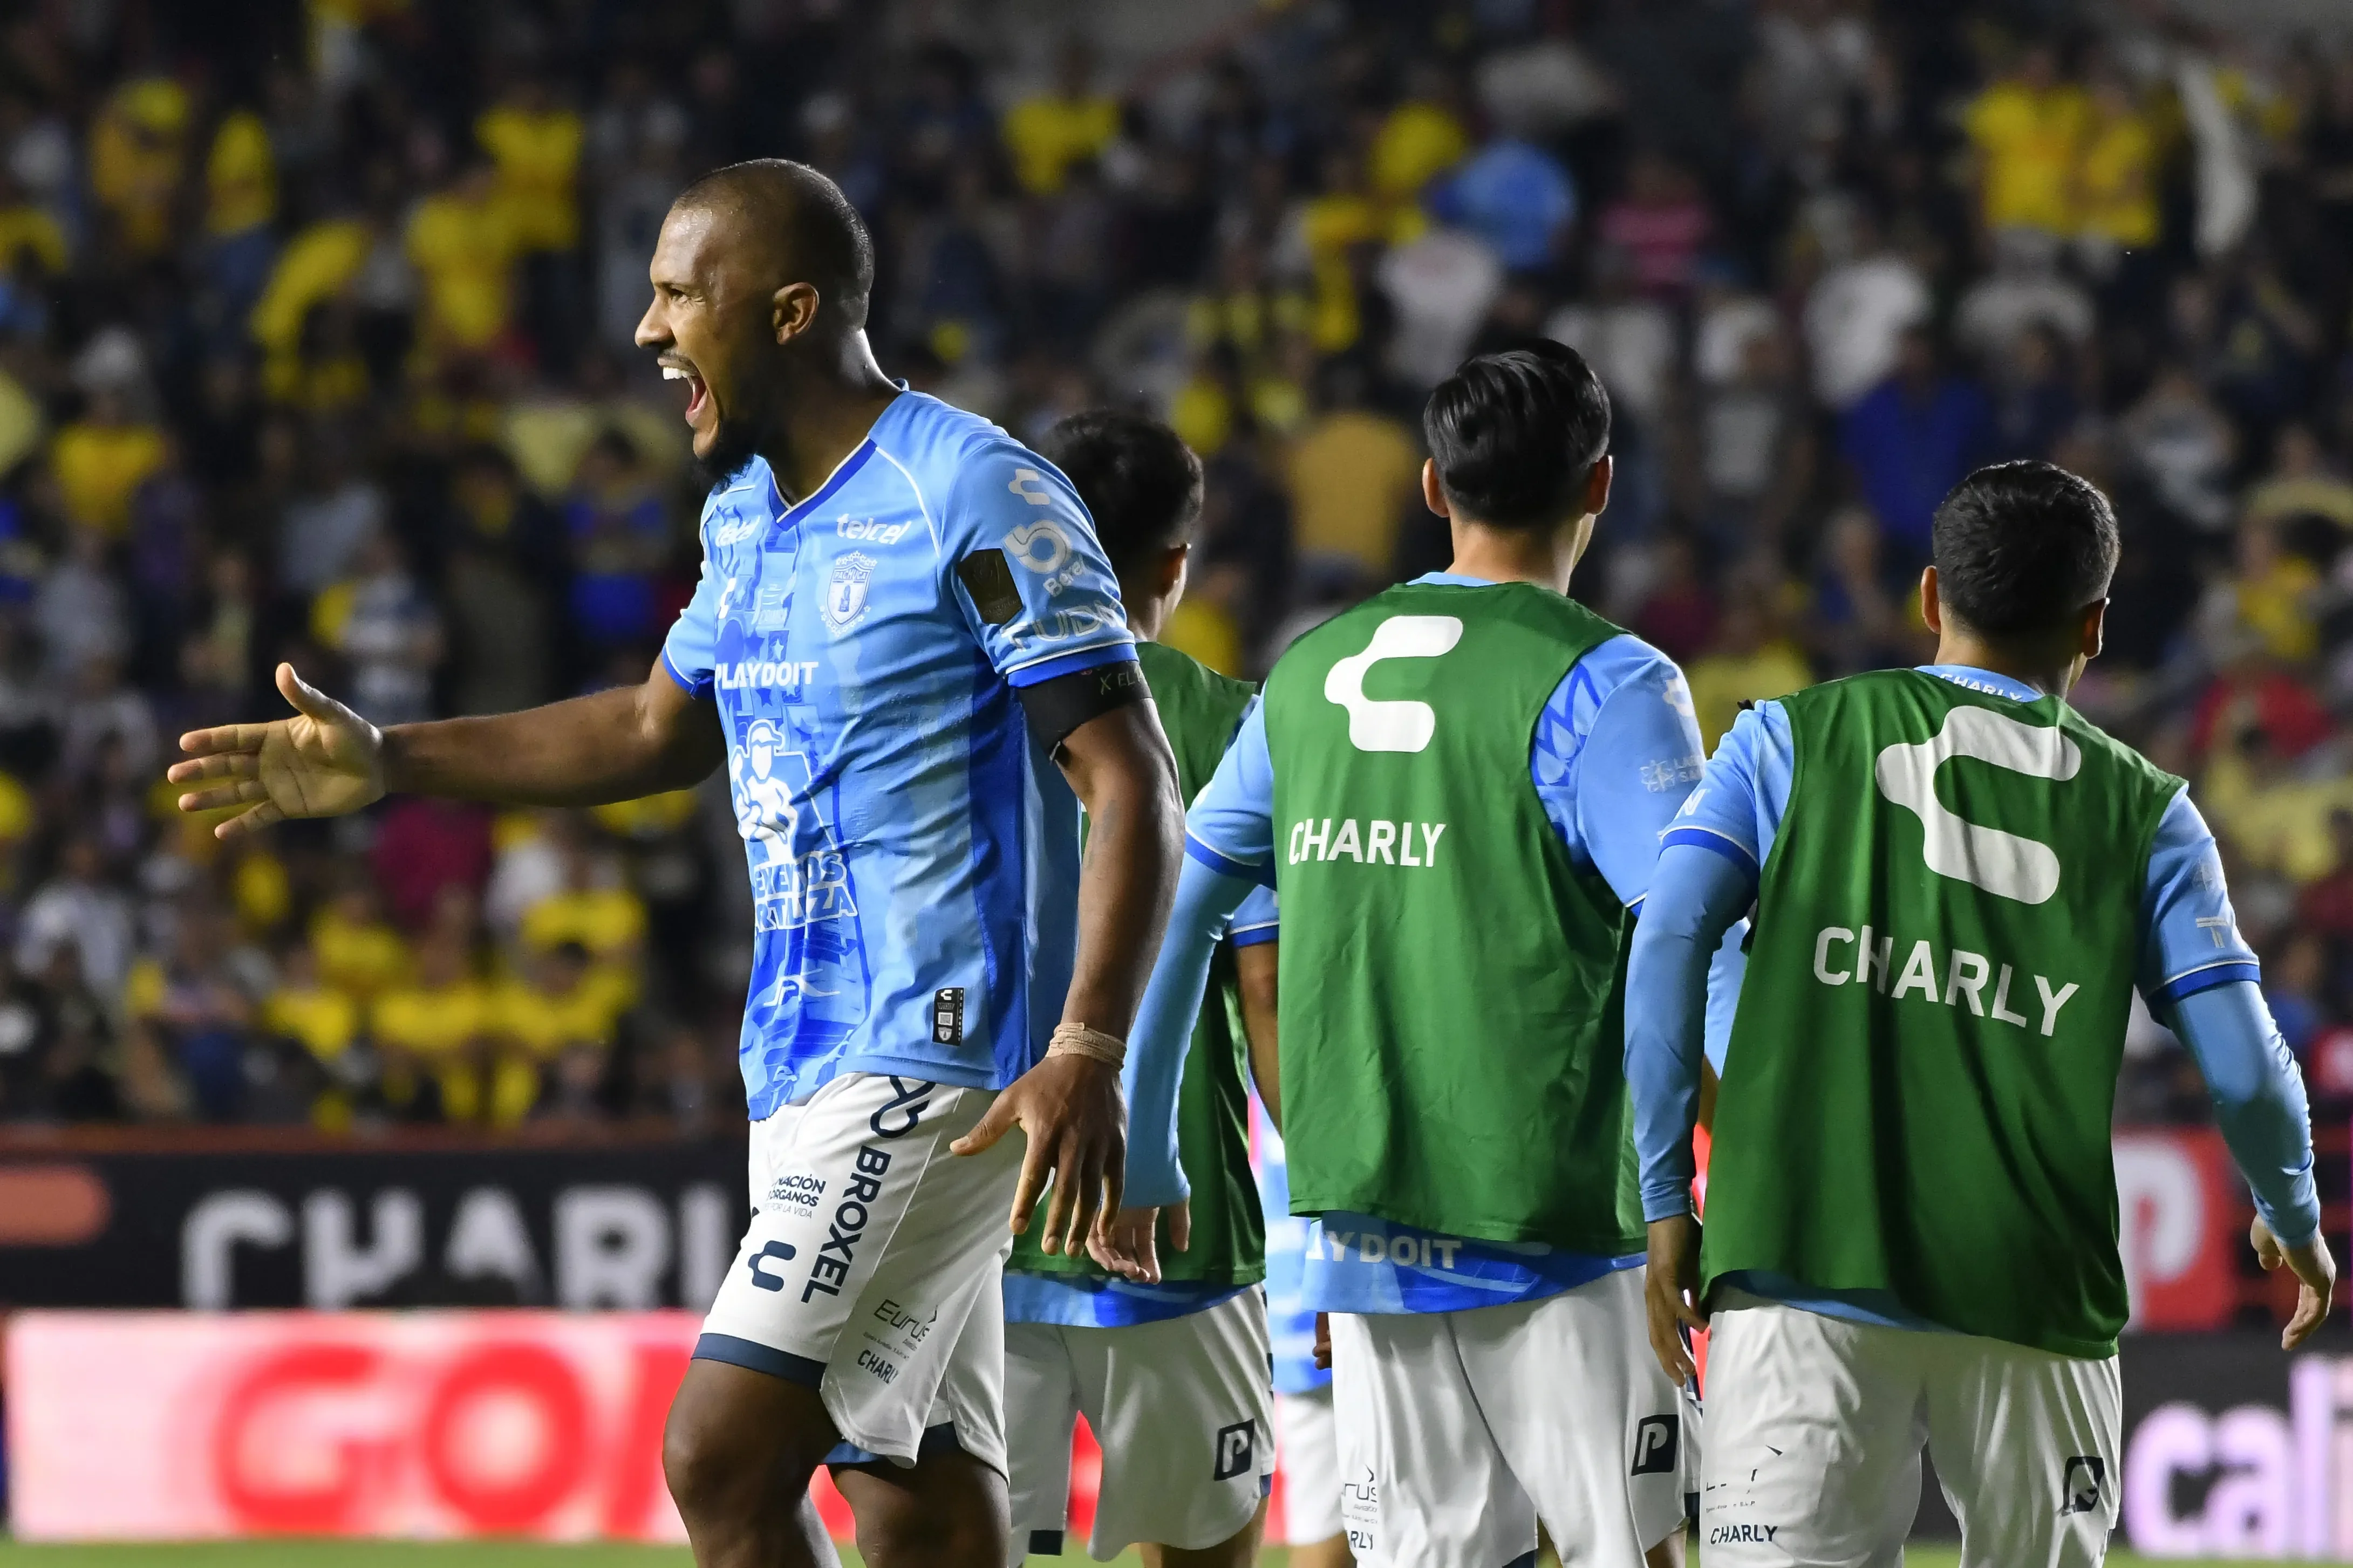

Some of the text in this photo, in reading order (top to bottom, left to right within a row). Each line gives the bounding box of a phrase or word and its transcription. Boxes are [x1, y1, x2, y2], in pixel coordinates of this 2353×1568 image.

[837, 513, 912, 545] telcel
[834, 569, 867, 580] PACHUCA
[714, 661, 819, 690] PLAYDOIT
[1288, 818, 1447, 867] CHARLY
[1813, 925, 2081, 1037] CHARLY
[794, 1206, 813, 1219] VIDA
[801, 1145, 892, 1304] BROXEL
[874, 1299, 930, 1343] Eurus
[1710, 1524, 1778, 1545] CHARLY
